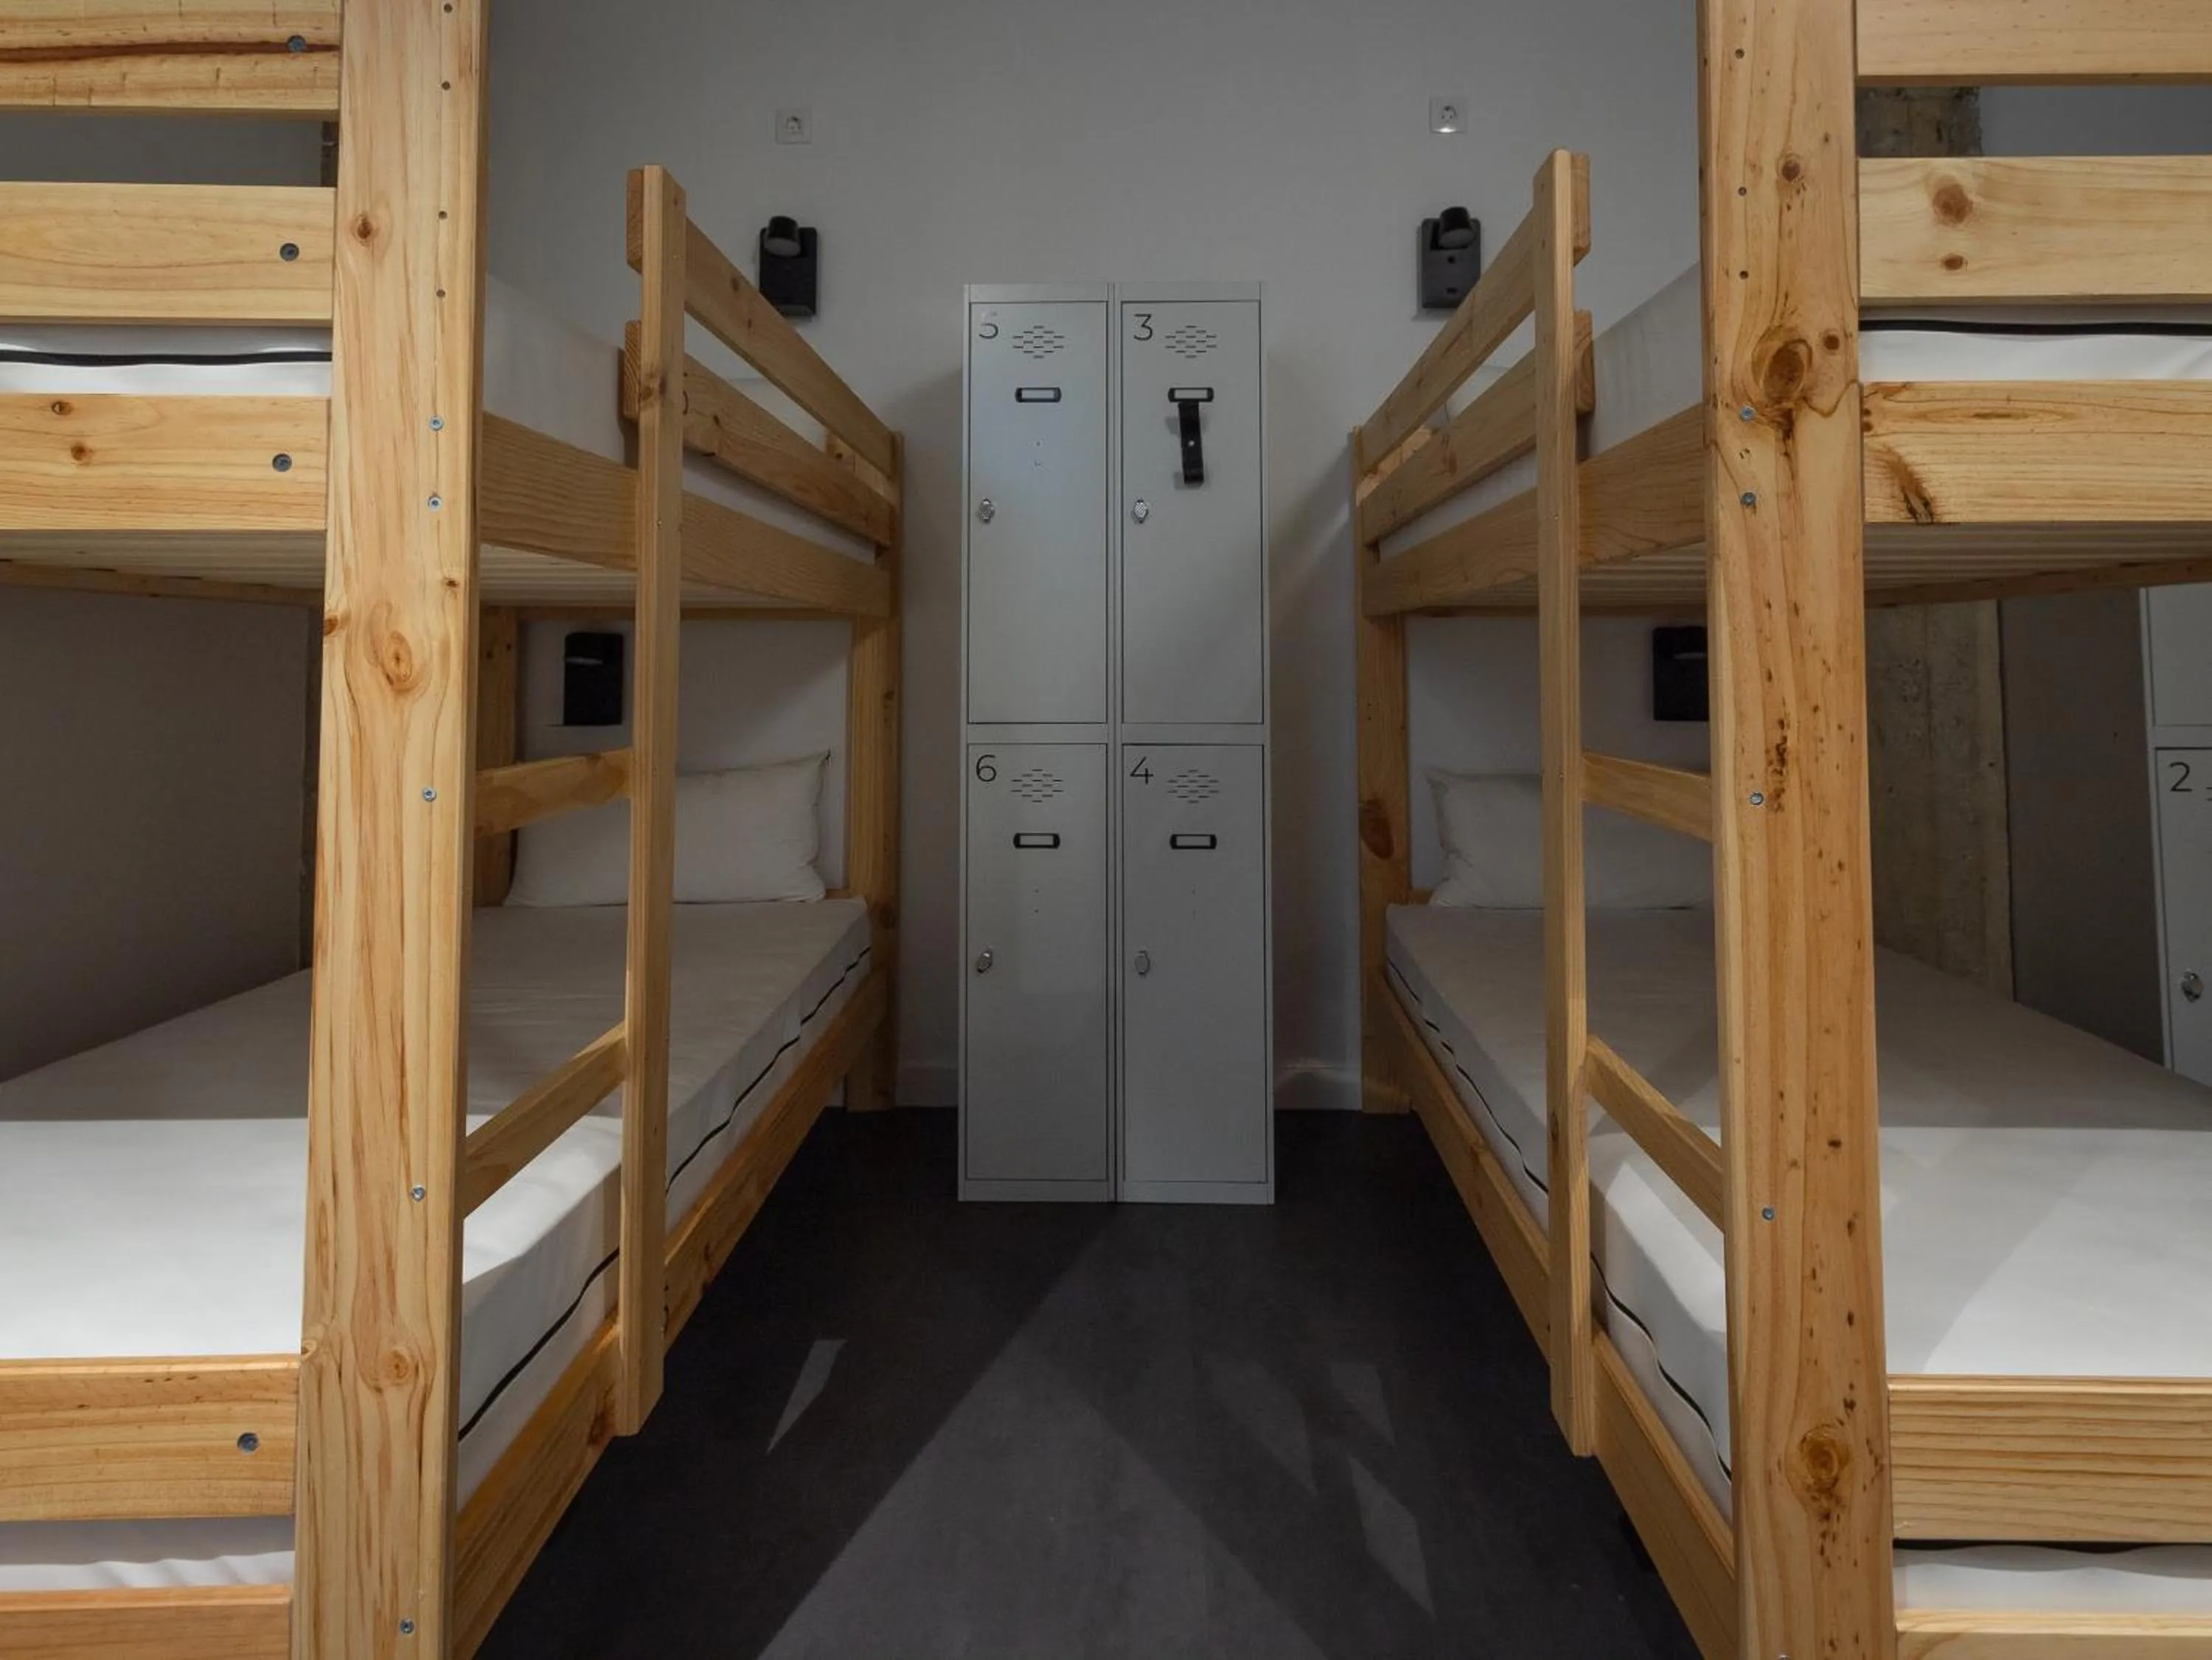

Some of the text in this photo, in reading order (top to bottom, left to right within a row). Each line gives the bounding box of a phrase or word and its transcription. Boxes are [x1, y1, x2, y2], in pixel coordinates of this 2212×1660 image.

[1133, 313, 1154, 341] 3
[975, 754, 997, 782] 6
[1130, 756, 1154, 784] 4
[2169, 761, 2193, 792] 2
